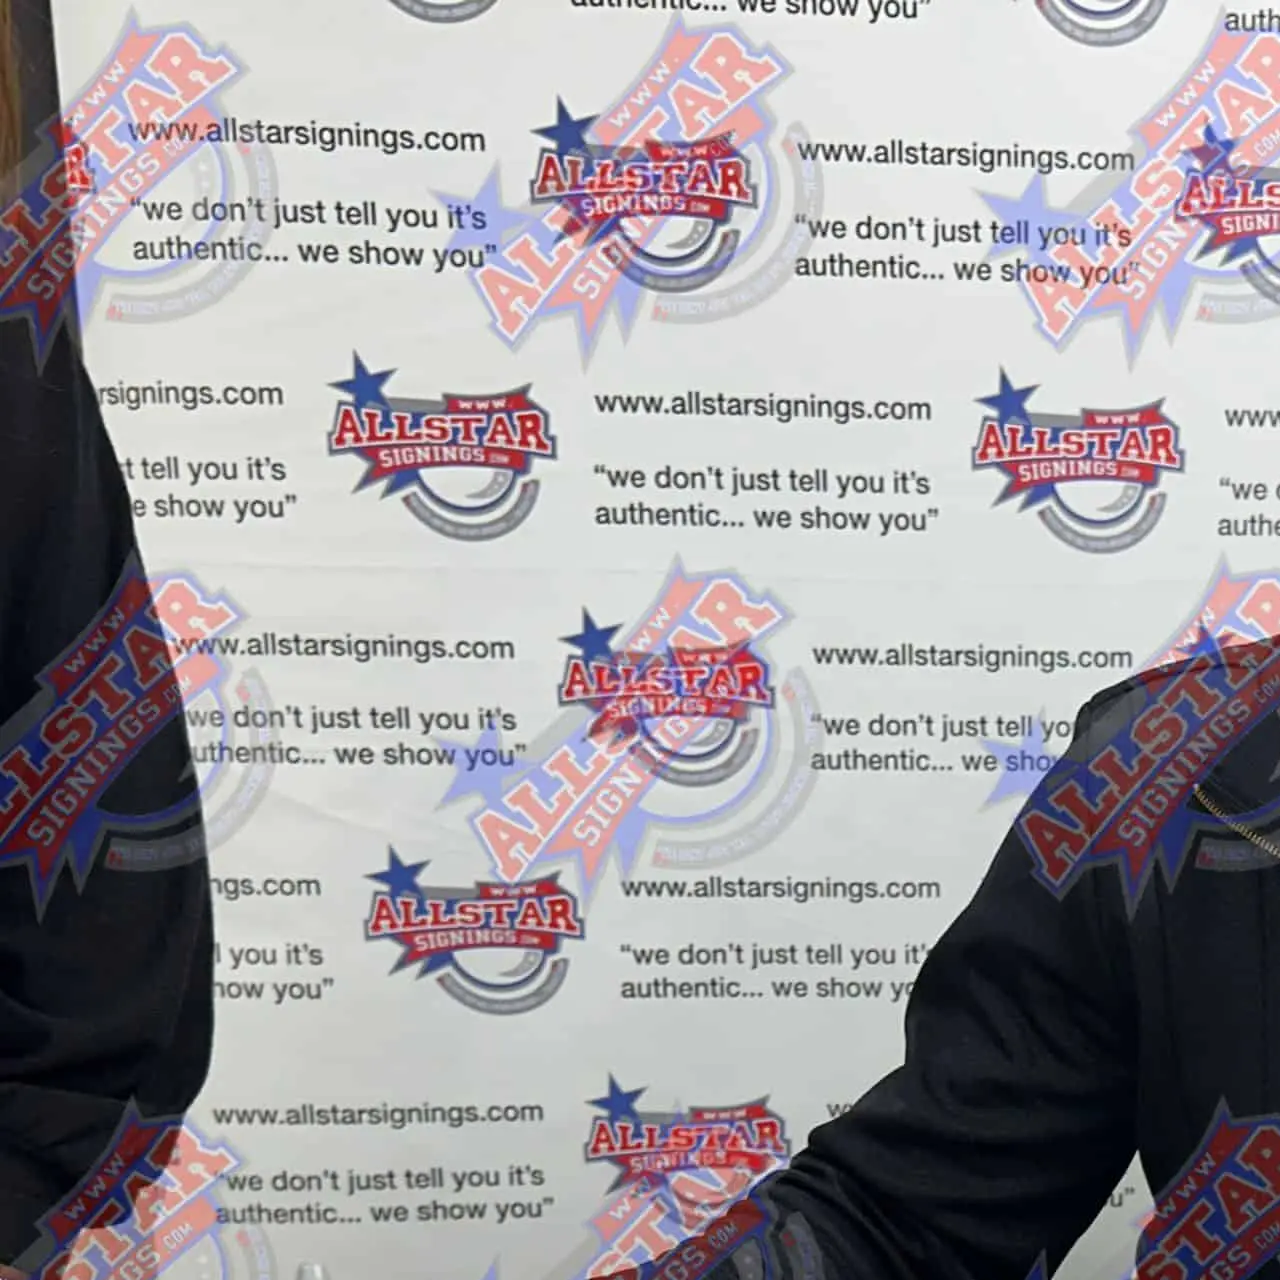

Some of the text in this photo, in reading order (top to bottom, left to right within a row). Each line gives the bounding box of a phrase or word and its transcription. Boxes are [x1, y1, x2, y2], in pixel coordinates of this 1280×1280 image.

[128, 117, 485, 155] www.allstarsignings.com
[797, 139, 1135, 175] www.allstarsignings.com
[533, 153, 752, 202] ALLSTAR
[273, 197, 326, 229] just
[334, 201, 377, 226] tell
[385, 208, 438, 233] you
[932, 218, 982, 248] just
[990, 221, 1028, 244] tell
[1038, 227, 1086, 251] you
[133, 235, 288, 262] authentic...
[297, 244, 339, 263] we
[348, 240, 424, 266] show
[794, 253, 944, 280] authentic...
[953, 261, 992, 281] we
[1001, 258, 1071, 283] show
[594, 391, 931, 424] www.allstarsignings.com
[332, 405, 551, 453] ALLSTAR
[380, 446, 485, 468] SIGNINGS
[976, 420, 1180, 468] ALLSTAR
[731, 467, 781, 496] just
[789, 469, 828, 492] tell
[836, 475, 884, 499] you
[1018, 461, 1117, 482] SIGNINGS
[595, 502, 744, 527] authentic...
[753, 510, 792, 528] we
[800, 506, 871, 530] show
[812, 643, 1133, 670] www.allstarsignings.com
[561, 659, 772, 702] ALLSTAR
[312, 706, 362, 734] just
[369, 706, 410, 729] tell
[418, 712, 469, 735] you
[941, 714, 988, 742] just
[996, 715, 1032, 737] tell
[193, 741, 325, 765] uthentic...
[333, 747, 375, 765] we
[383, 742, 455, 765] show
[621, 876, 940, 903] www.allstarsignings.com
[368, 895, 579, 937] ALLSTAR
[413, 930, 516, 951] SIGNINGS
[752, 944, 798, 970] just
[806, 944, 842, 965] tell
[850, 948, 896, 970] you
[621, 976, 883, 998] authentic... we show
[213, 1103, 543, 1129] www.allstarsignings.com
[588, 1119, 785, 1157] ALLSTAR
[348, 1170, 397, 1196] just
[404, 1168, 444, 1189] tell
[451, 1171, 500, 1193] you
[216, 1201, 361, 1224] authentic...
[370, 1206, 409, 1222] we
[417, 1200, 487, 1221] show
